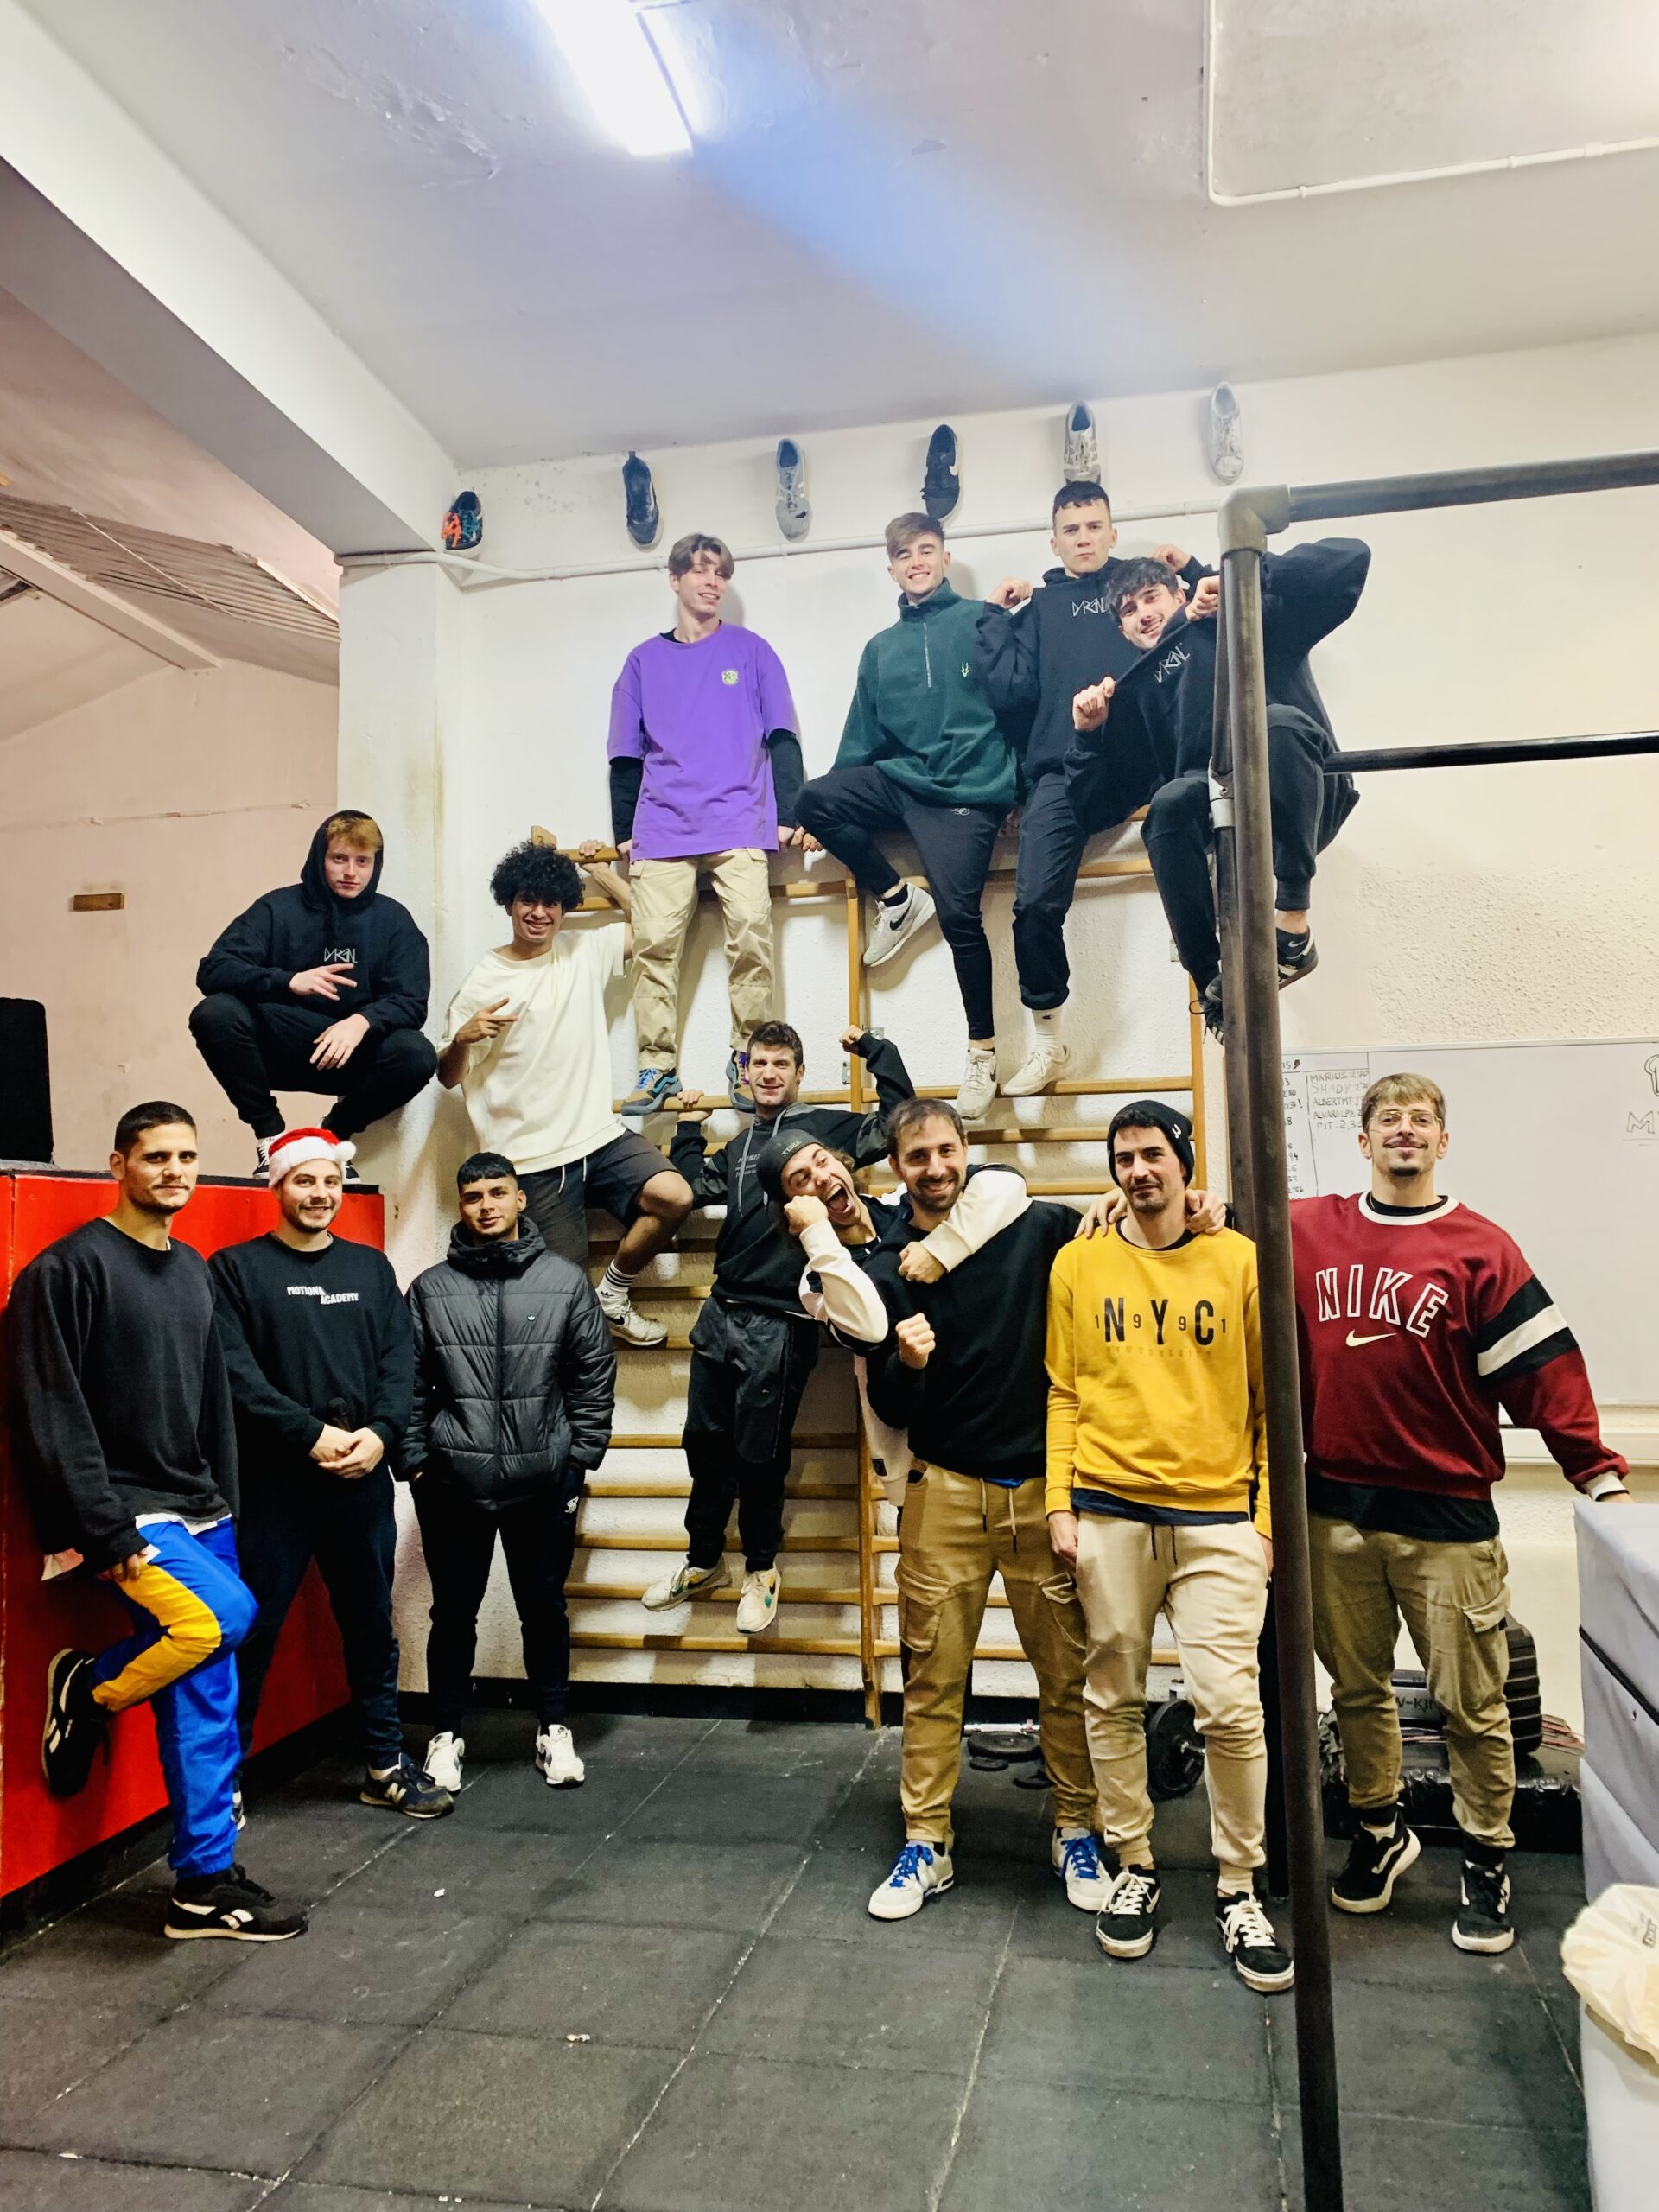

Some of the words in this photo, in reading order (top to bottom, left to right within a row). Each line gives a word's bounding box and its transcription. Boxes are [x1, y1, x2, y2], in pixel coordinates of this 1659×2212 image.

[1310, 1071, 1348, 1083] MARIUS
[1626, 1110, 1659, 1134] M
[320, 1293, 359, 1305] ACADEMY
[1315, 1264, 1449, 1338] NIKE
